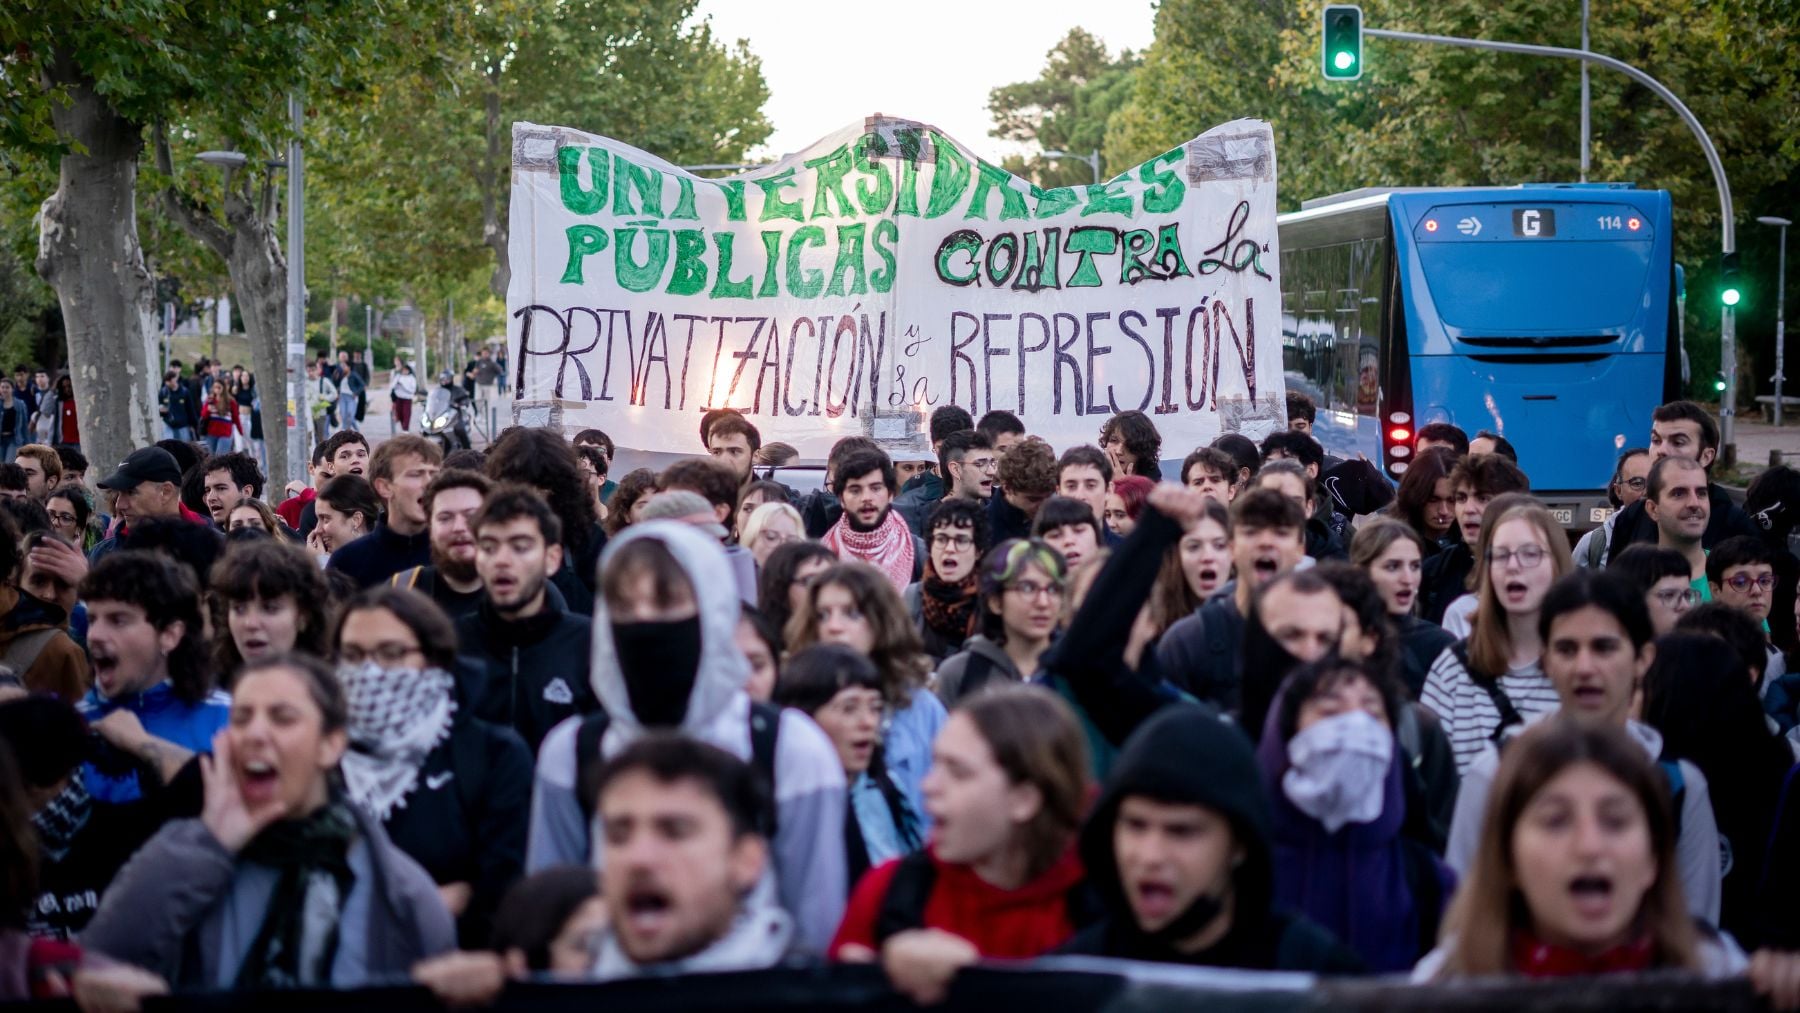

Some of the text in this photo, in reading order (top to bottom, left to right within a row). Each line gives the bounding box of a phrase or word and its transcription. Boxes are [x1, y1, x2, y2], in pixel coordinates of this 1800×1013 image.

[1522, 209, 1541, 237] G
[1597, 215, 1622, 230] 114
[559, 219, 898, 299] PÚBLICAS
[935, 222, 1194, 292] CONTRA
[513, 303, 886, 418] PRIVATIZACIÓN
[904, 324, 932, 357] y
[950, 296, 1255, 417] REPRESIÓN
